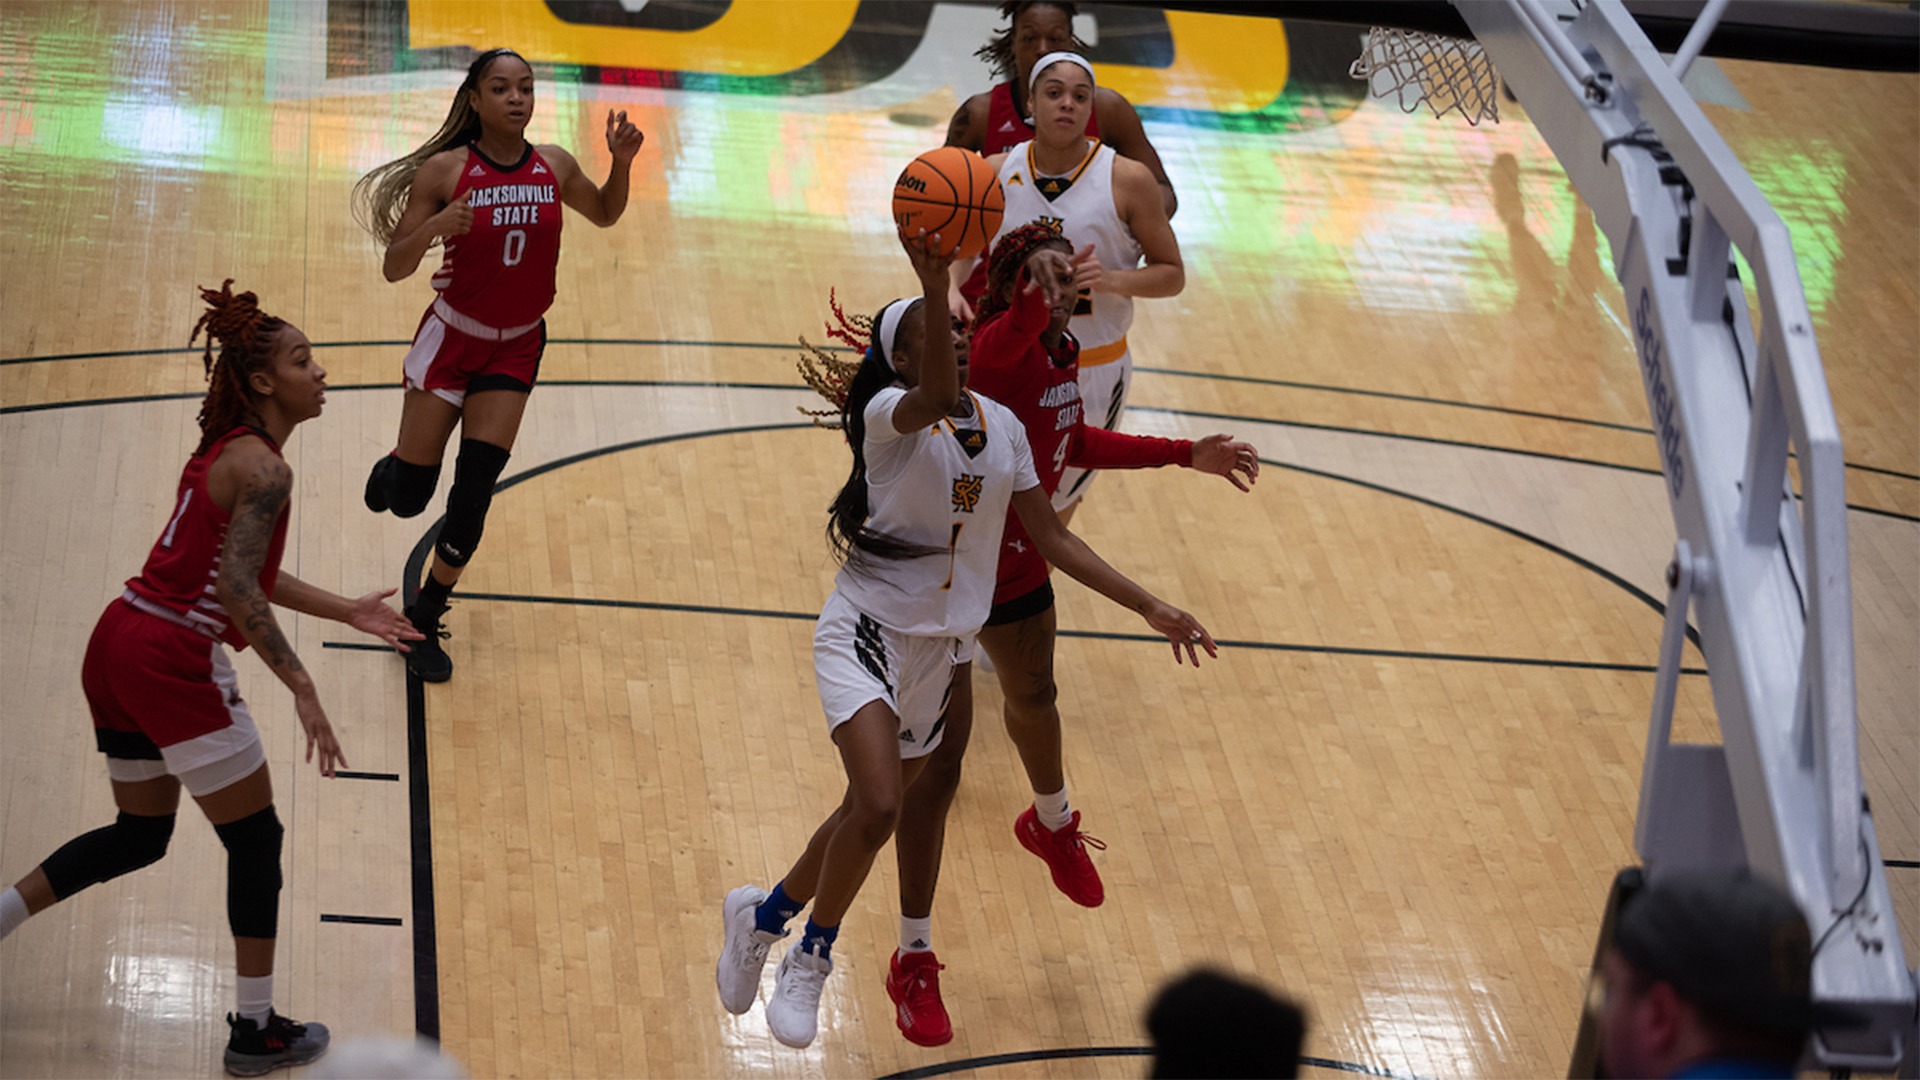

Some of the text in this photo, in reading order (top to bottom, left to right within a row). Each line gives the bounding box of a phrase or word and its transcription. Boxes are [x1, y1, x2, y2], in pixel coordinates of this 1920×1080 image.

[467, 184, 555, 208] JACKSONVILLE
[492, 205, 539, 226] STATE
[502, 229, 527, 267] 0
[1636, 286, 1684, 499] Schelde
[1053, 432, 1070, 472] 4
[162, 488, 193, 547] 1
[940, 521, 964, 590] 1
